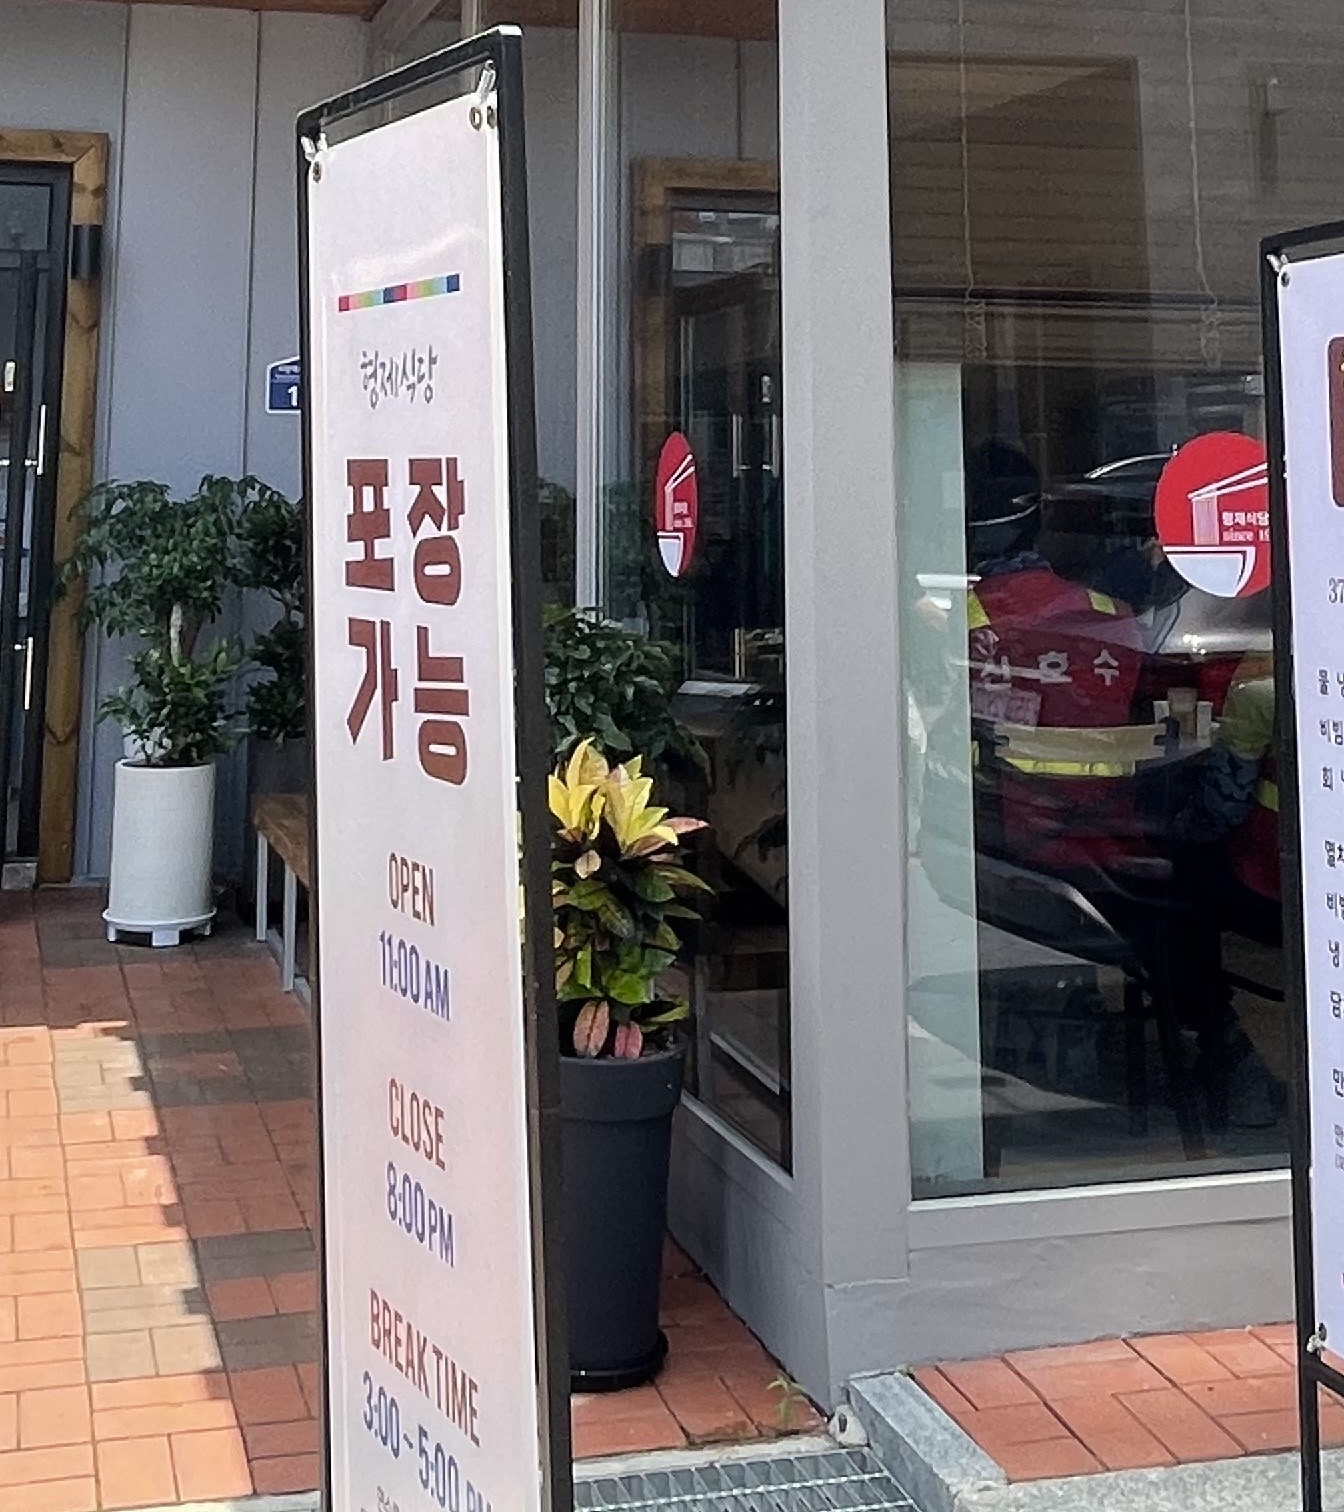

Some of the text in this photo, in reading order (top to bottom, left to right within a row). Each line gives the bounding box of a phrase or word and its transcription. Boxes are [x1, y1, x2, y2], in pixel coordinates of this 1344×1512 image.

[361, 345, 439, 411] 형제식당
[345, 455, 467, 608] 포장
[346, 617, 470, 787] 가능
[389, 852, 435, 927] OPEN
[388, 1077, 446, 1172] CLOSE
[370, 1288, 480, 1448] BREAK TIME
